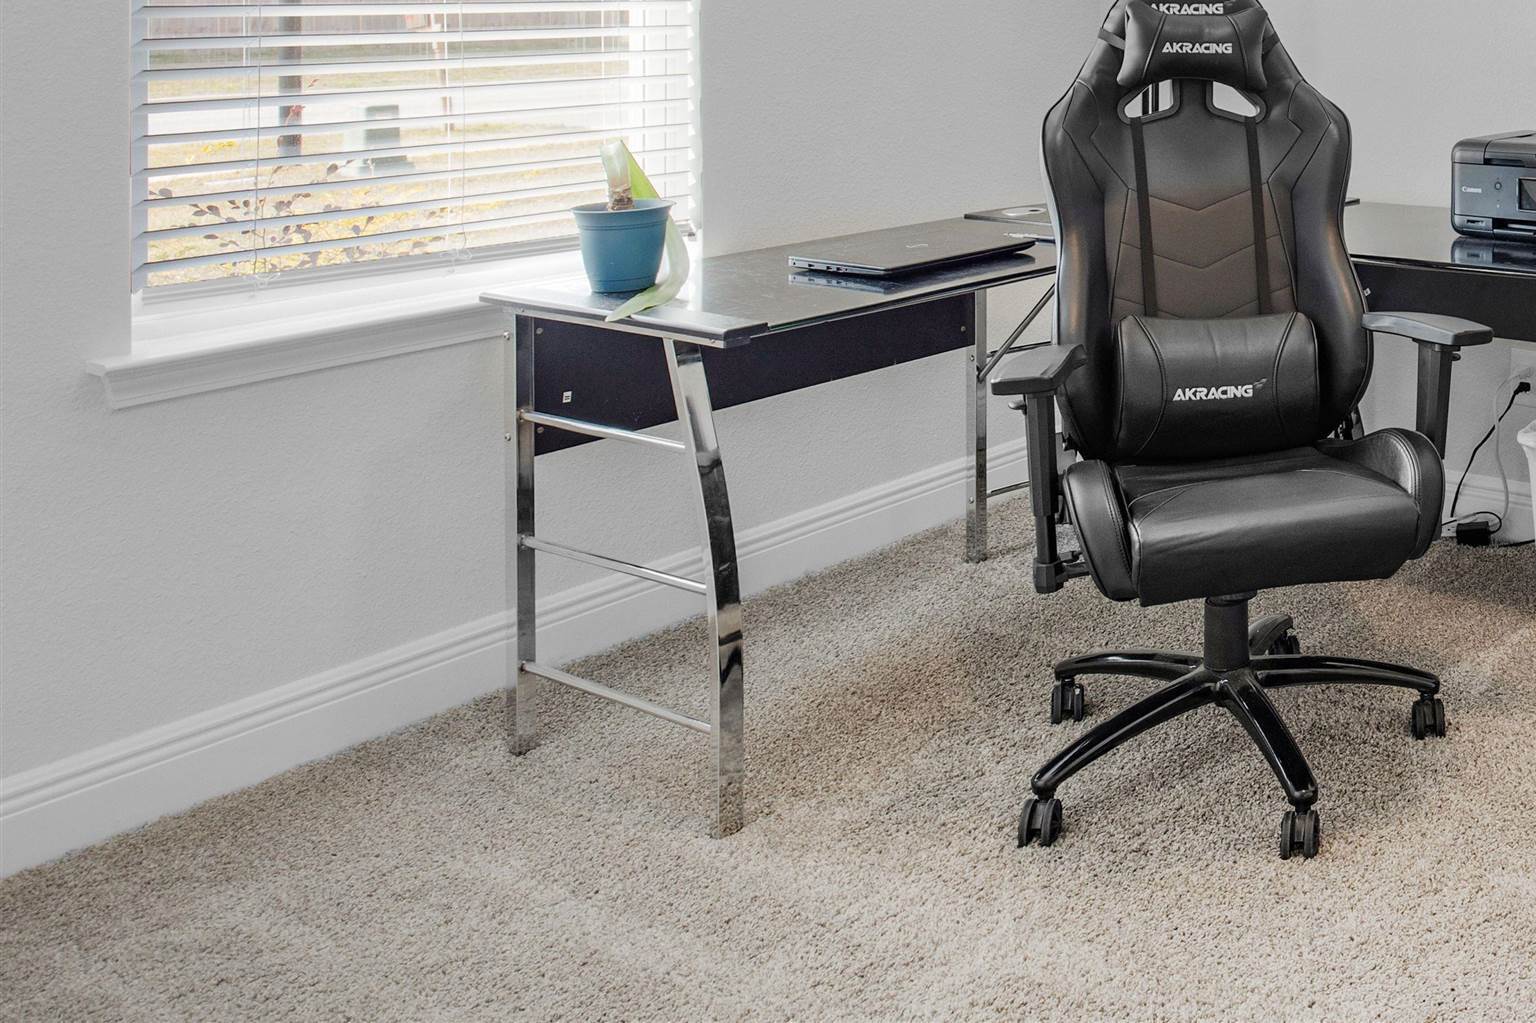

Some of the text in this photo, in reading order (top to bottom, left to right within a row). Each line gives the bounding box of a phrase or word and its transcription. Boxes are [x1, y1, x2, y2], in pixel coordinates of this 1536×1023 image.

[1151, 2, 1224, 15] AKRACING
[1162, 42, 1233, 54] AKRACING
[1172, 384, 1254, 401] AKRACING
